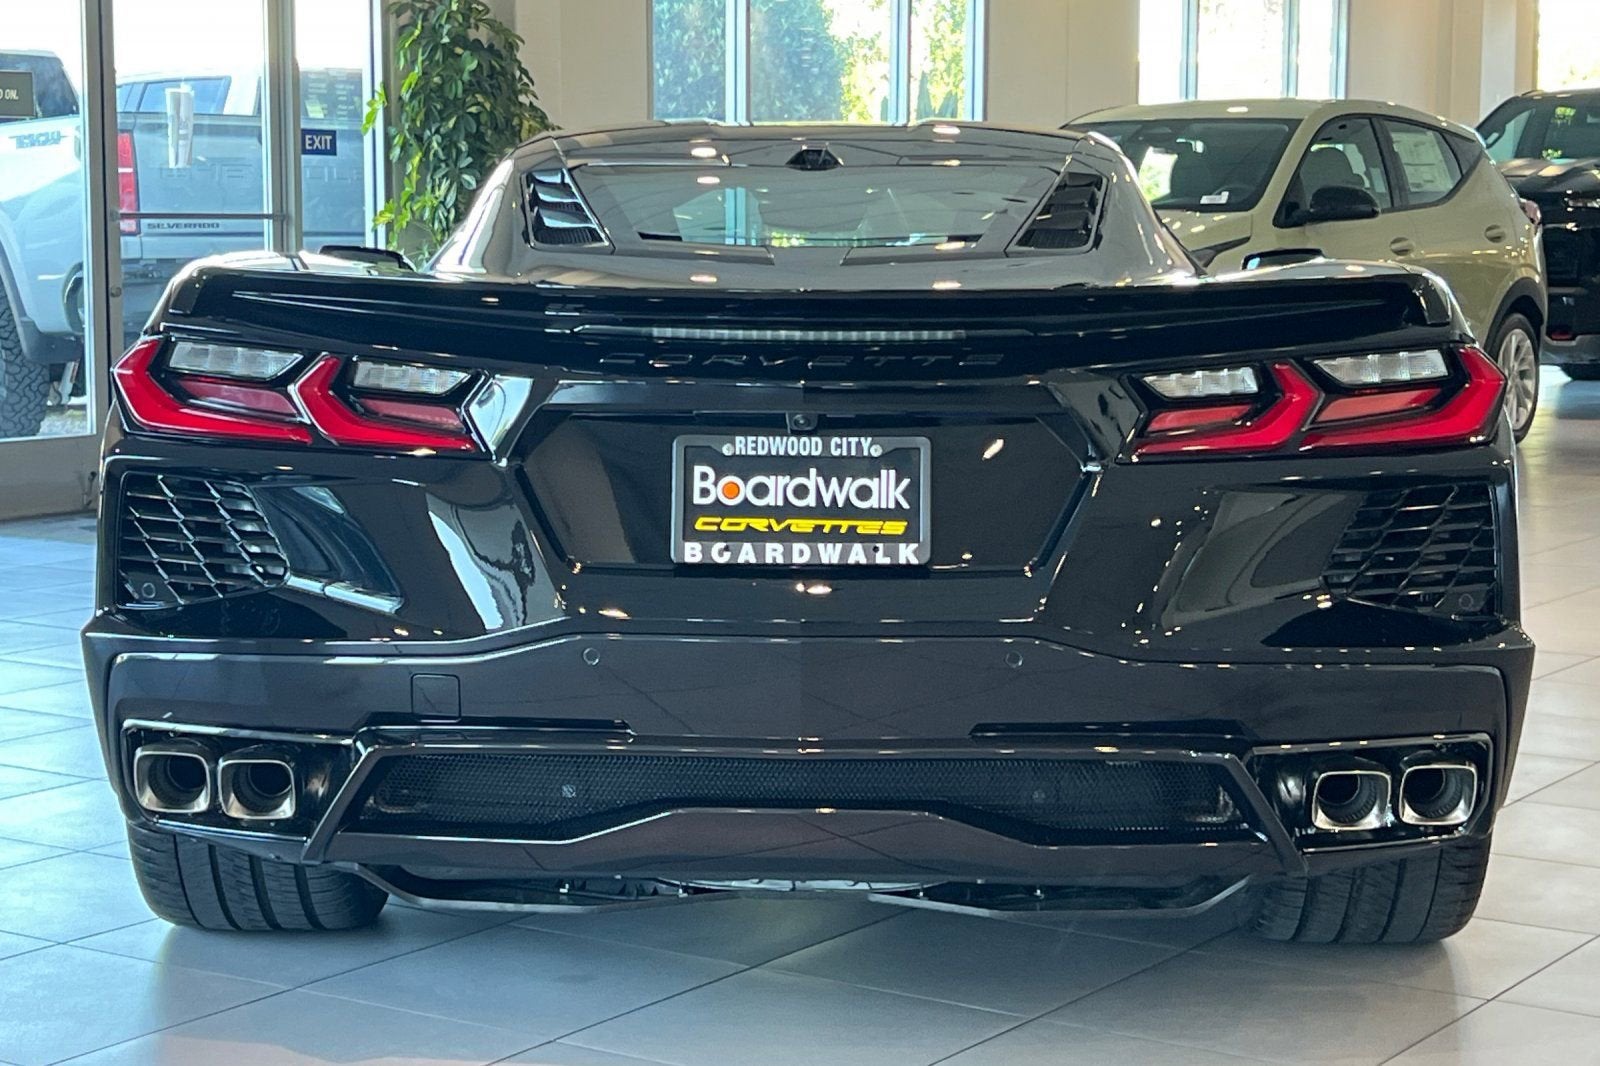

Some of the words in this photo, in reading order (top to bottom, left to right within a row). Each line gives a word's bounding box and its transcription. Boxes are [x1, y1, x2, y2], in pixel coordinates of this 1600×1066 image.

[4, 88, 19, 100] ON.
[304, 134, 333, 150] EXIT
[147, 222, 220, 230] SILVERADO
[599, 353, 1005, 370] CORVETTE
[734, 436, 823, 456] REDWOOD
[830, 436, 873, 456] CITY
[692, 465, 912, 510] Boardwalk
[693, 516, 909, 536] CORVETTES
[683, 541, 920, 565] BOARDWALK
